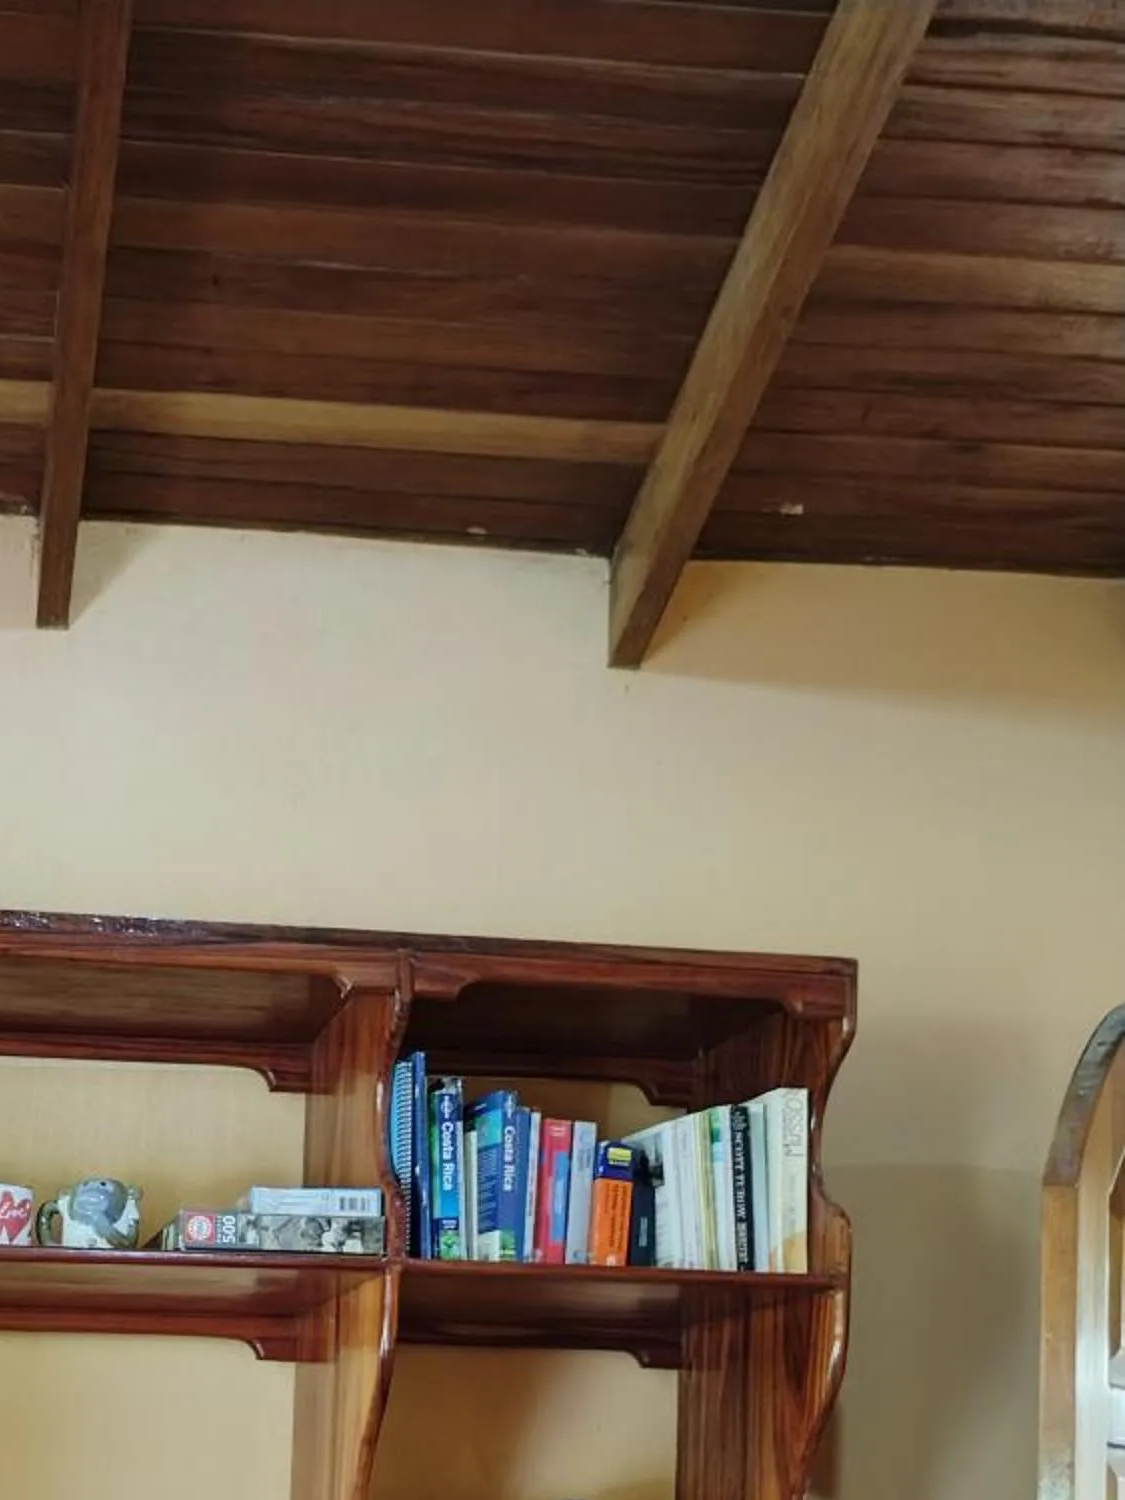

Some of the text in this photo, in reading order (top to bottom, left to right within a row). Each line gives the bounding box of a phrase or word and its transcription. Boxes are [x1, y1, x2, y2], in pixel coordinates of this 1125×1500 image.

[441, 1121, 456, 1161] Costa
[504, 1125, 516, 1162] Costa
[442, 1162, 456, 1191] Rica
[502, 1163, 516, 1192] Rica
[223, 1214, 236, 1243] 500
